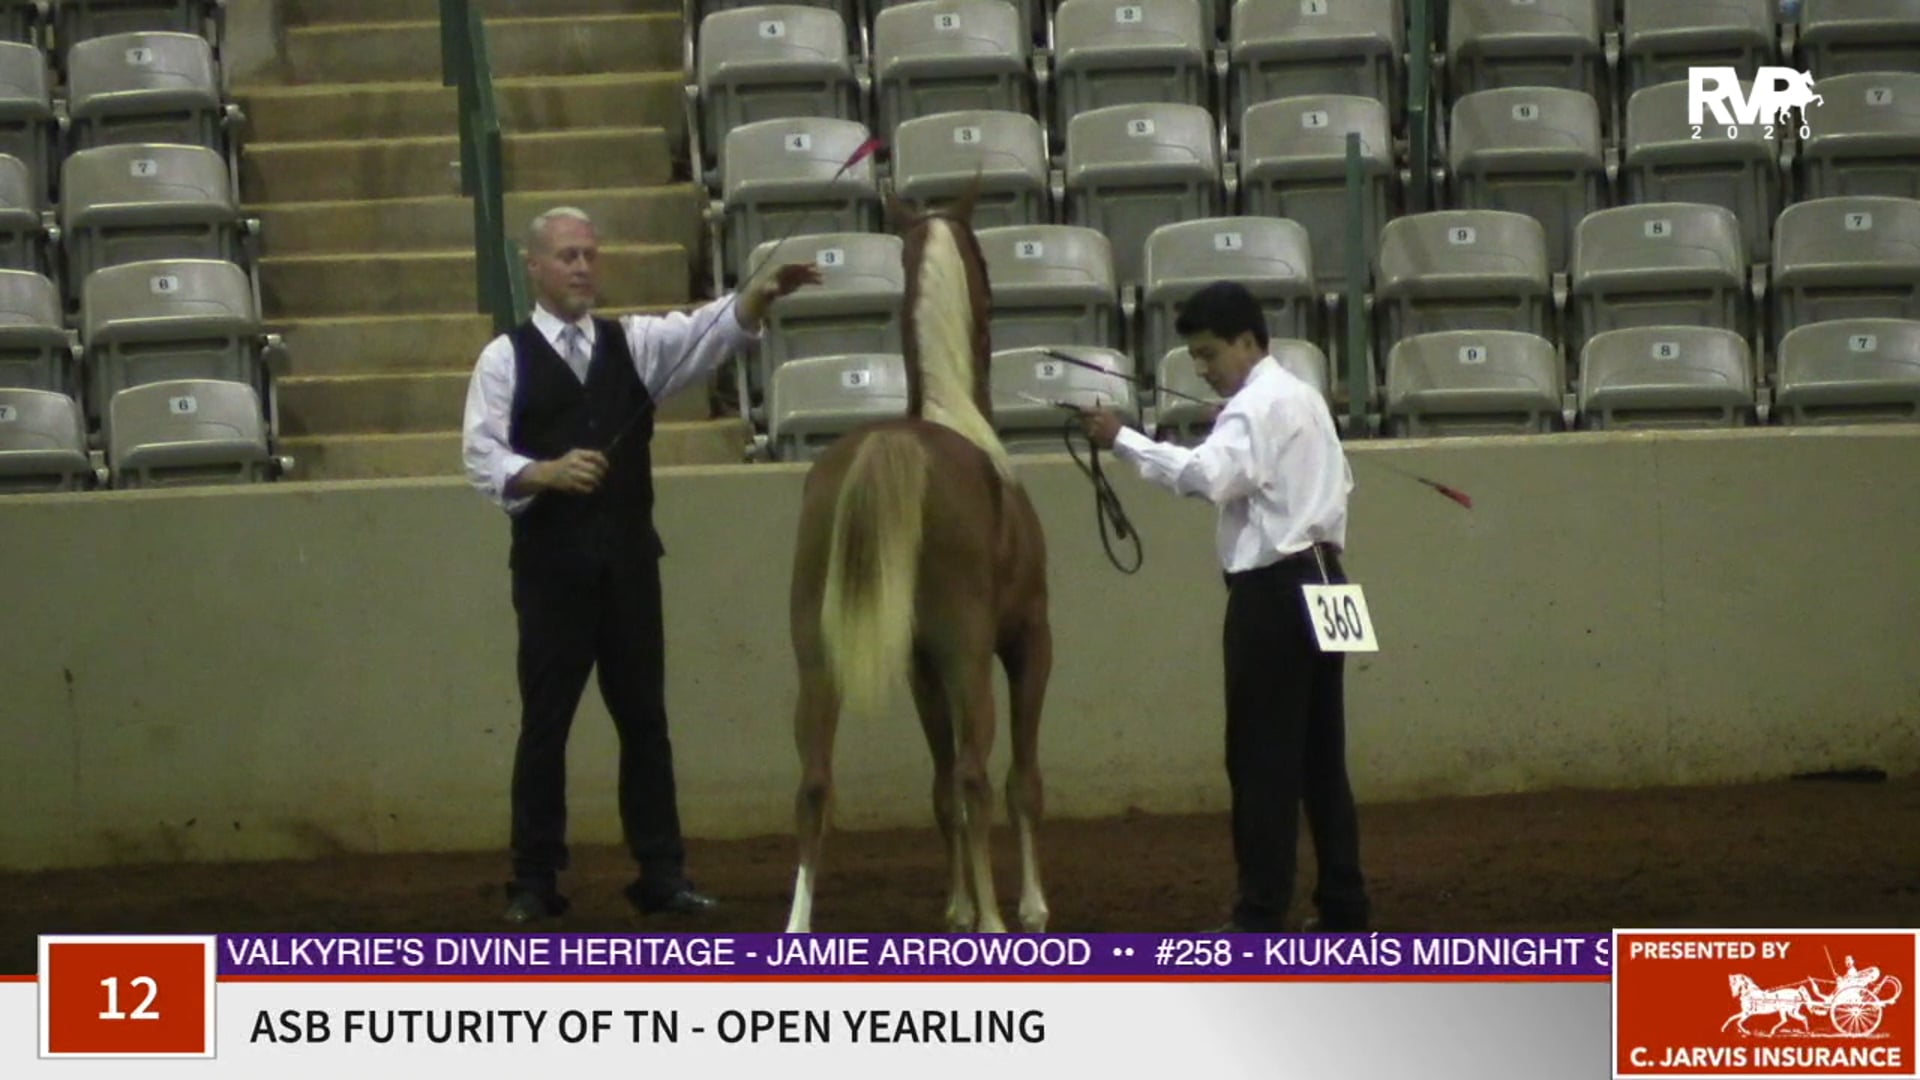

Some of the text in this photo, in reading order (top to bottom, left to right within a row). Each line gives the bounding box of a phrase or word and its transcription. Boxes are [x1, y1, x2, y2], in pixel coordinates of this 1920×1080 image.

[1123, 8, 1134, 20] 2
[942, 16, 953, 27] 3
[767, 24, 777, 35] 4
[133, 50, 144, 61] 7
[1873, 90, 1884, 102] 7
[1135, 122, 1146, 133] 2
[962, 129, 973, 141] 3
[793, 137, 803, 148] 4
[138, 162, 148, 174] 7
[1853, 215, 1863, 227] 7
[1653, 222, 1663, 234] 8
[1457, 229, 1468, 241] 9
[1024, 243, 1034, 255] 2
[825, 252, 835, 264] 3
[1858, 337, 1868, 349] 7
[1467, 348, 1478, 361] 9
[1660, 344, 1671, 356] 8
[1043, 364, 1054, 376] 2
[850, 373, 861, 385] 3
[178, 399, 189, 411] 6
[1317, 594, 1363, 641] 360
